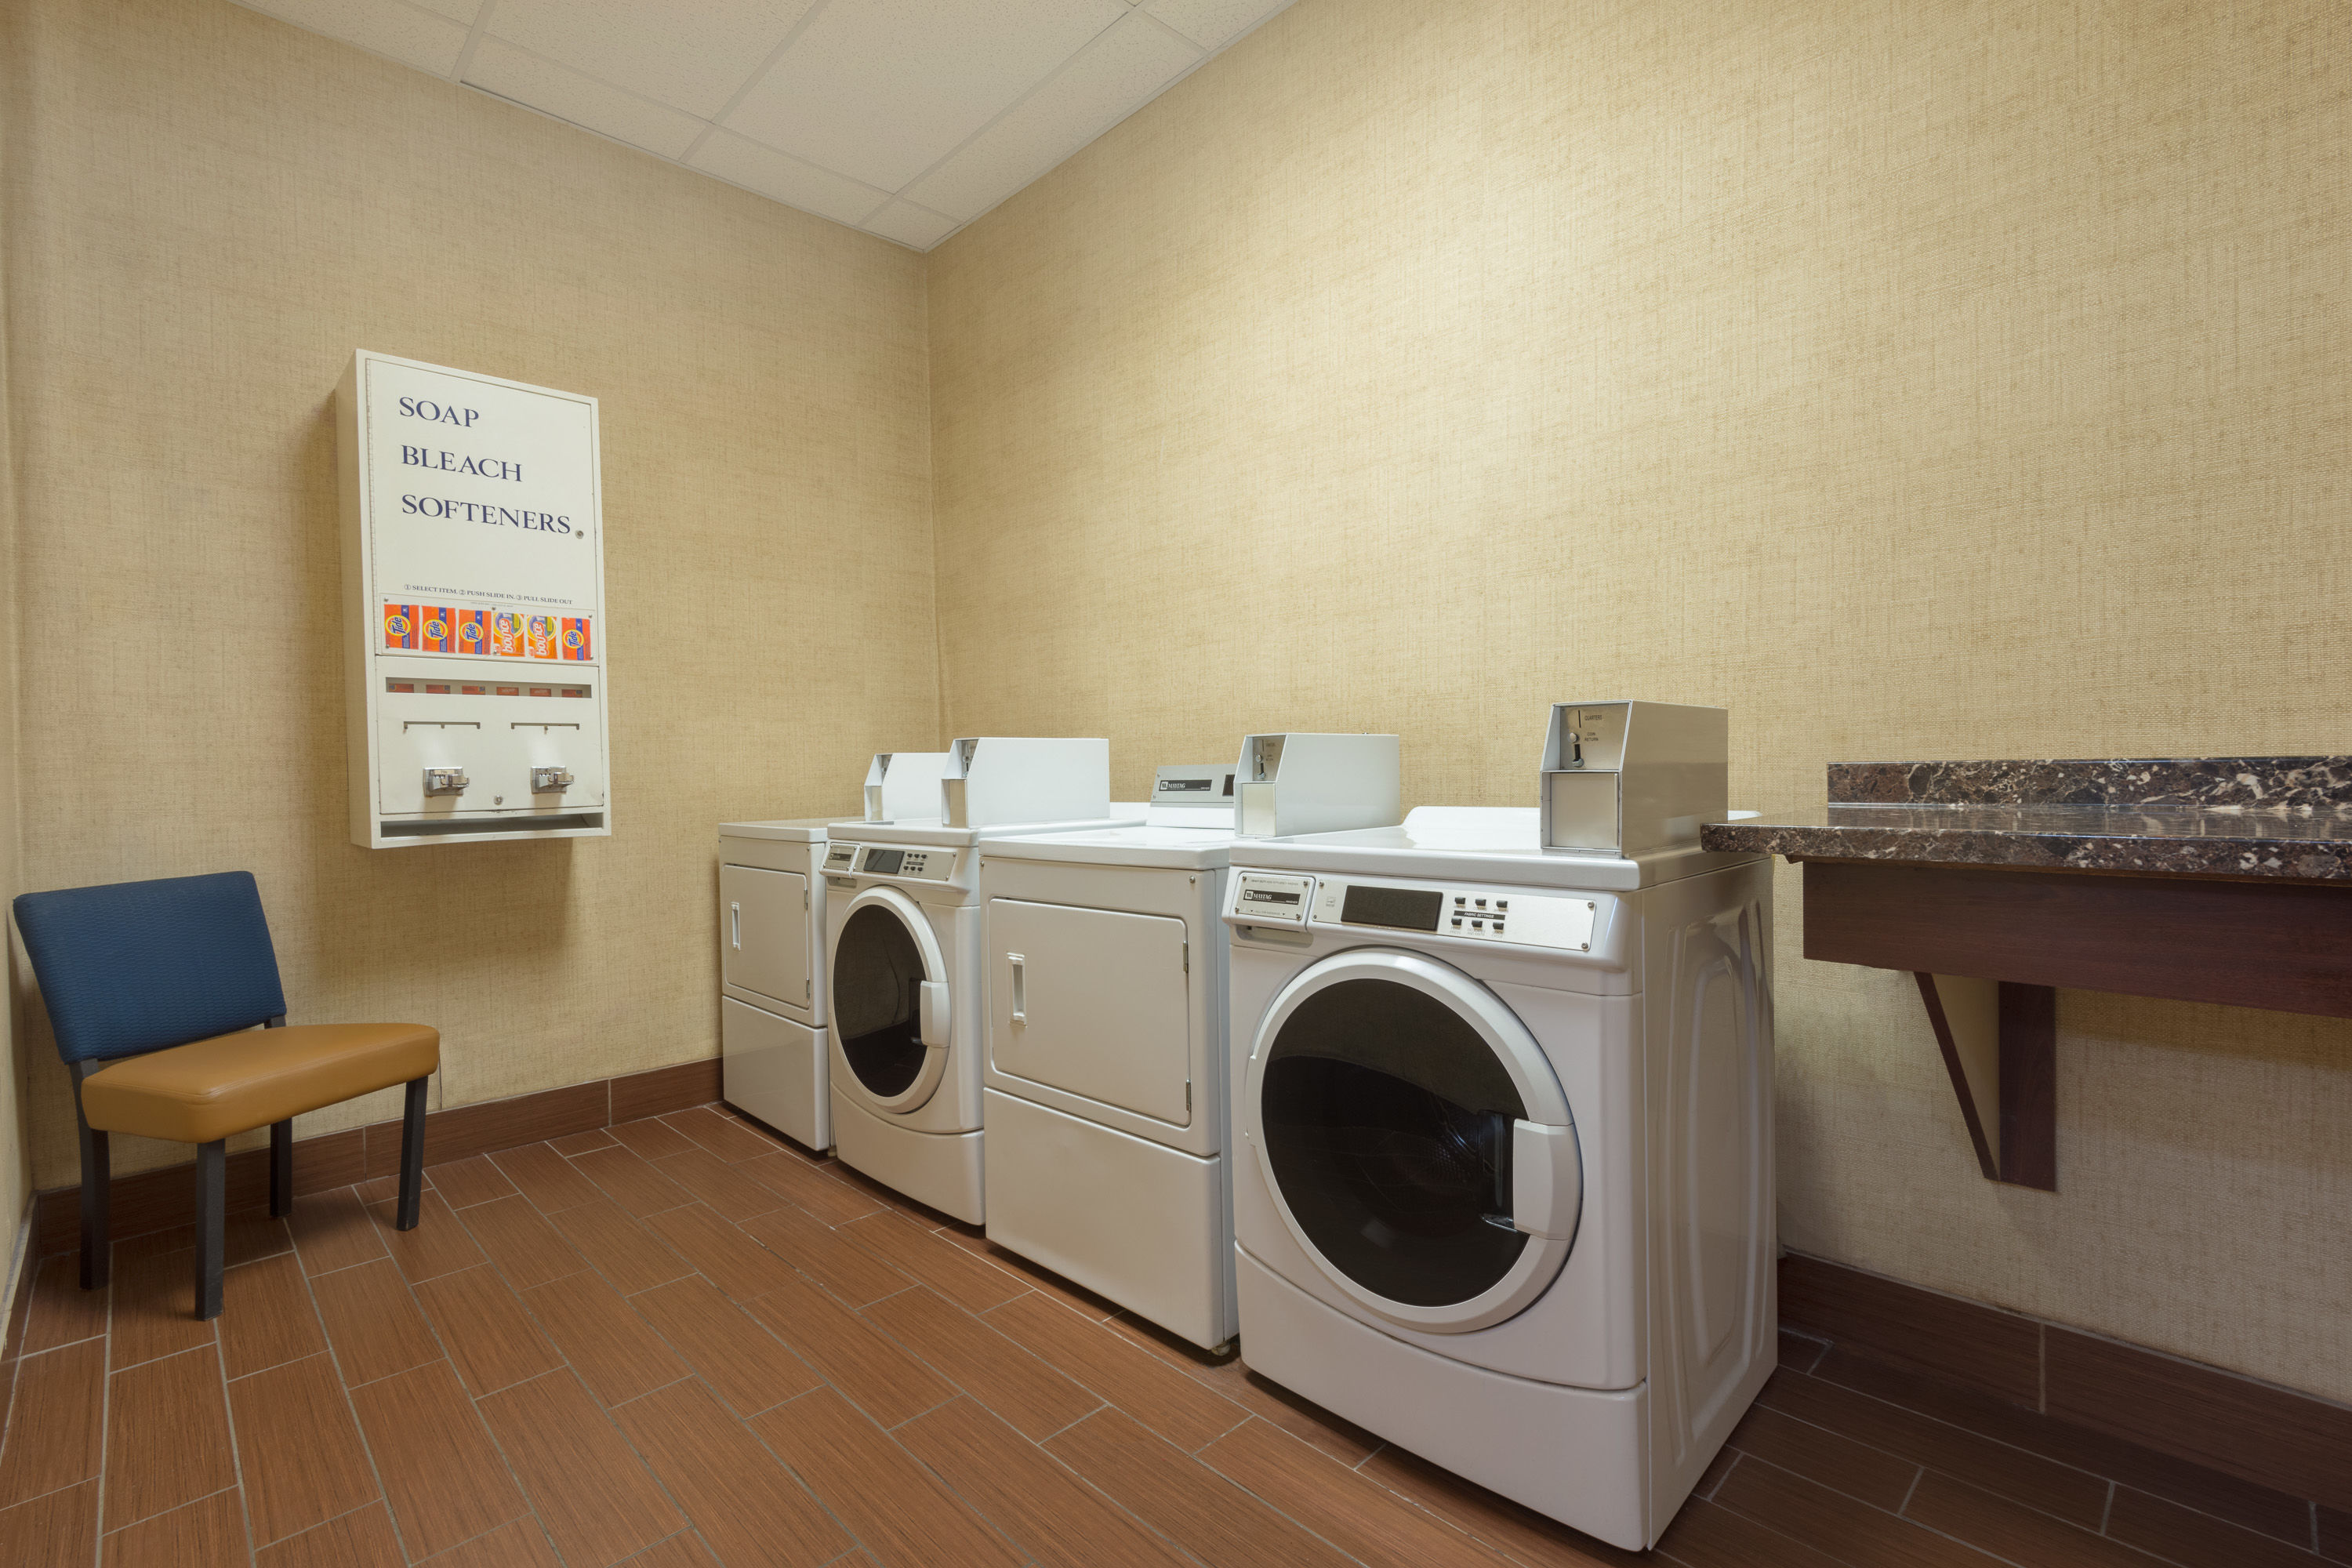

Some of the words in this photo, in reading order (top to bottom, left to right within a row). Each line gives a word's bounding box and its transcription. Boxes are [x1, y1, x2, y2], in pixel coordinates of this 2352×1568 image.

[398, 397, 480, 428] SOAP
[401, 445, 523, 482] BLEACH
[401, 494, 571, 534] SOFTENERS
[391, 616, 406, 634] Tide
[430, 621, 445, 638] Tide
[466, 623, 480, 641] Tide
[567, 630, 581, 647] Tide
